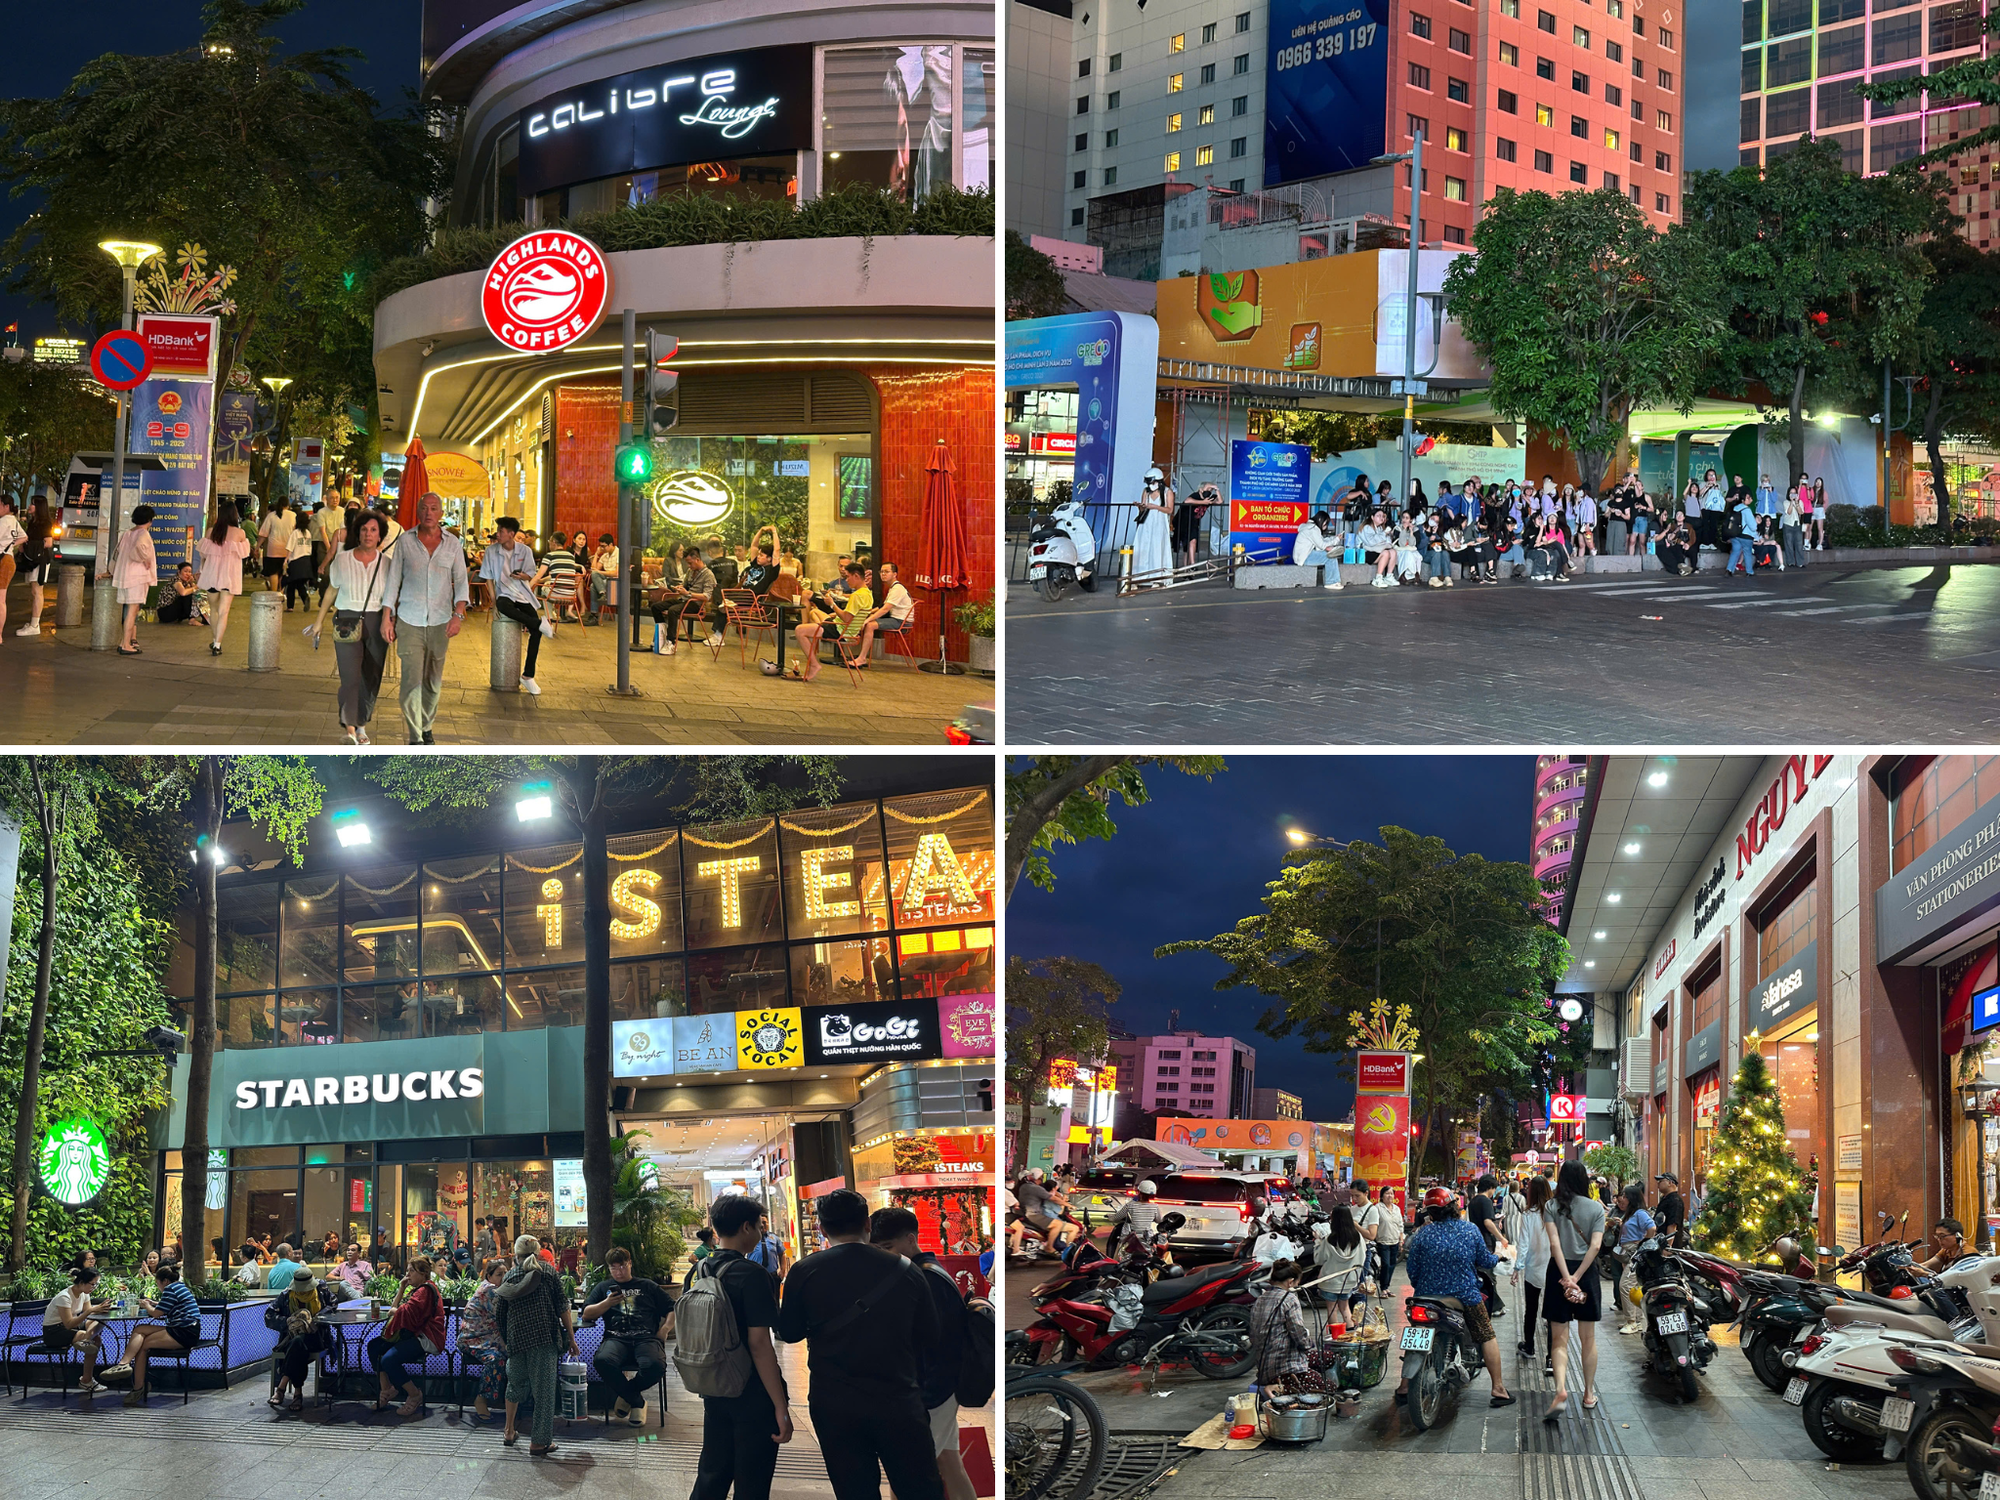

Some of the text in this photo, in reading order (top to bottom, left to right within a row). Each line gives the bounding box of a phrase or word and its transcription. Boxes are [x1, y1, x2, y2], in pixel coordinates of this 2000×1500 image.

[1291, 9, 1362, 39] LIÊN HỆ QUẢNG CÁO
[1276, 22, 1377, 72] 0966 339 197
[678, 94, 780, 139] Lounge
[488, 237, 599, 291] HIGHLANDS
[501, 314, 586, 347] COFFEE
[148, 334, 194, 346] HDBank
[54, 347, 80, 355] HOTEL
[146, 422, 190, 438] 2-9
[1906, 839, 1972, 898] VĂN PHÒNG
[1769, 968, 1802, 1007] fahasa
[740, 1012, 798, 1039] SOCIAL
[965, 1019, 985, 1028] EVE
[677, 1046, 733, 1061] BE AN
[742, 1045, 798, 1066] LOCAL
[822, 1042, 922, 1056] QUÁN THỊT NƯỚNG HÀN QUỐC
[620, 1050, 666, 1065] By night
[1363, 1065, 1395, 1073] HDBank
[235, 1067, 484, 1110] STARBUCKS
[1558, 1101, 1568, 1112] K
[934, 1162, 984, 1173] iSTEAKS
[1407, 1328, 1430, 1338] 59-XB
[1660, 1322, 1686, 1334] 024.96
[1402, 1338, 1429, 1349] 354.48
[1887, 1400, 1908, 1415] 63-C1
[1881, 1413, 1908, 1429] 521.67
